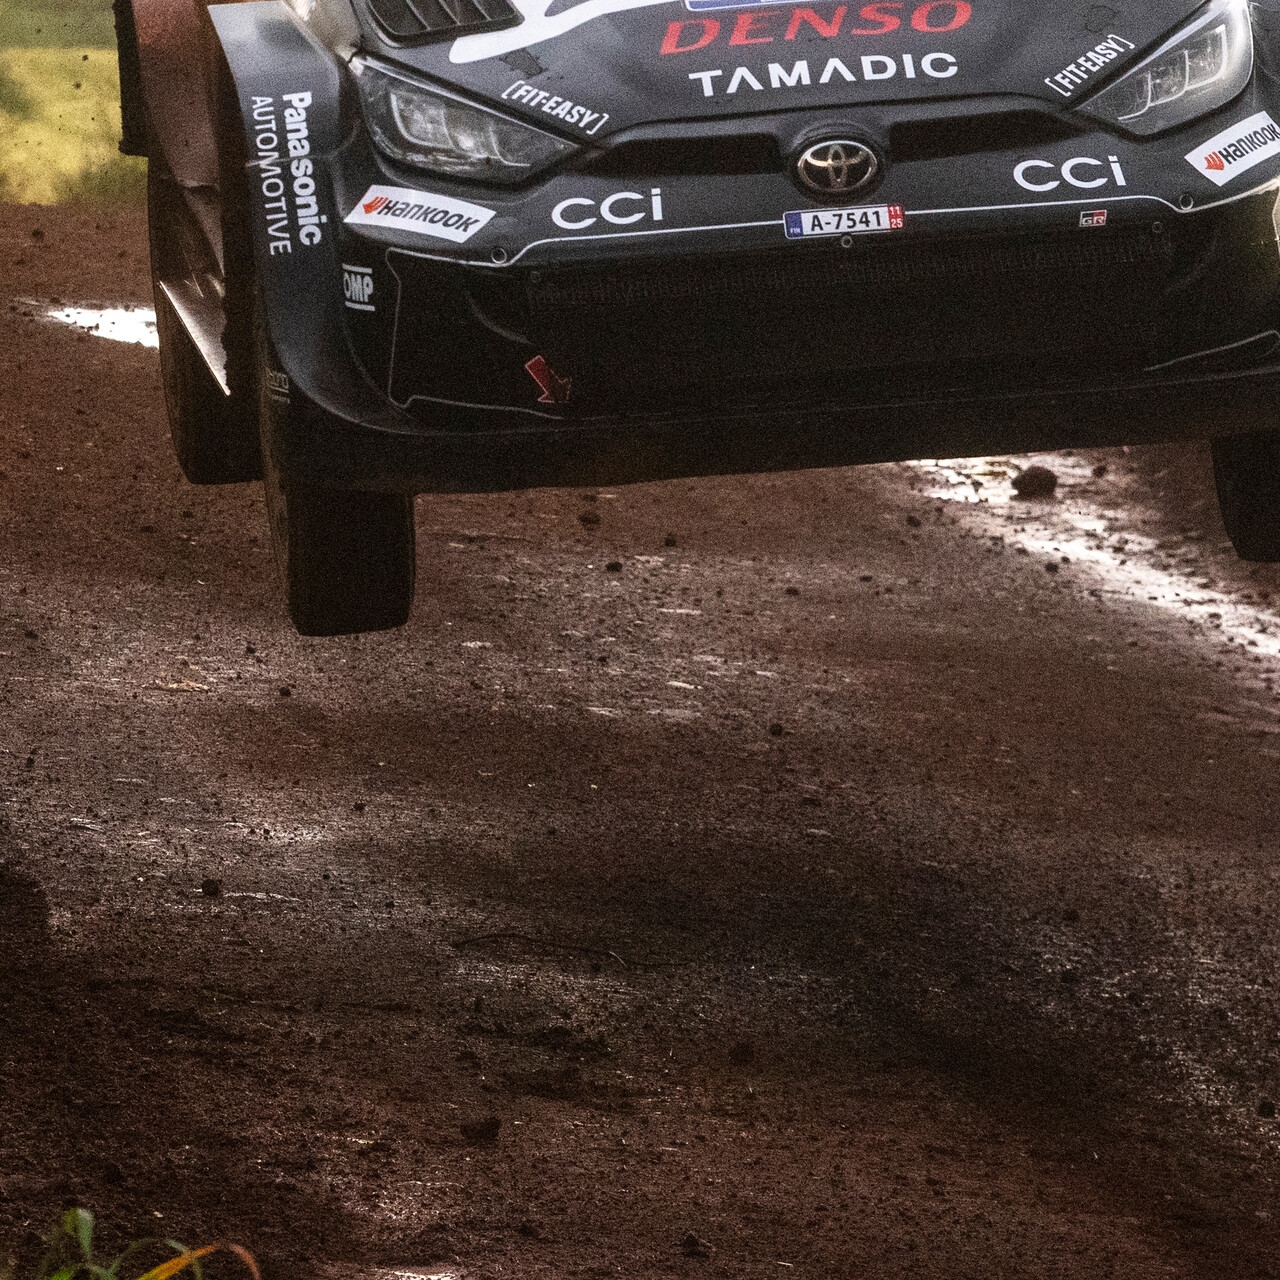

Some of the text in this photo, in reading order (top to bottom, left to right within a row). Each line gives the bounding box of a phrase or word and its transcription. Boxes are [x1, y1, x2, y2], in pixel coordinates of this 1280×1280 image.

[659, 0, 972, 55] DENSO
[688, 52, 958, 97] TAMADIC
[251, 96, 291, 255] AUTOMOTIVE
[282, 90, 326, 246] Panasonic
[811, 211, 881, 231] A-7541
[889, 206, 901, 215] 11
[891, 218, 903, 228] 25
[1082, 213, 1106, 226] GR
[343, 270, 374, 303] OMP
